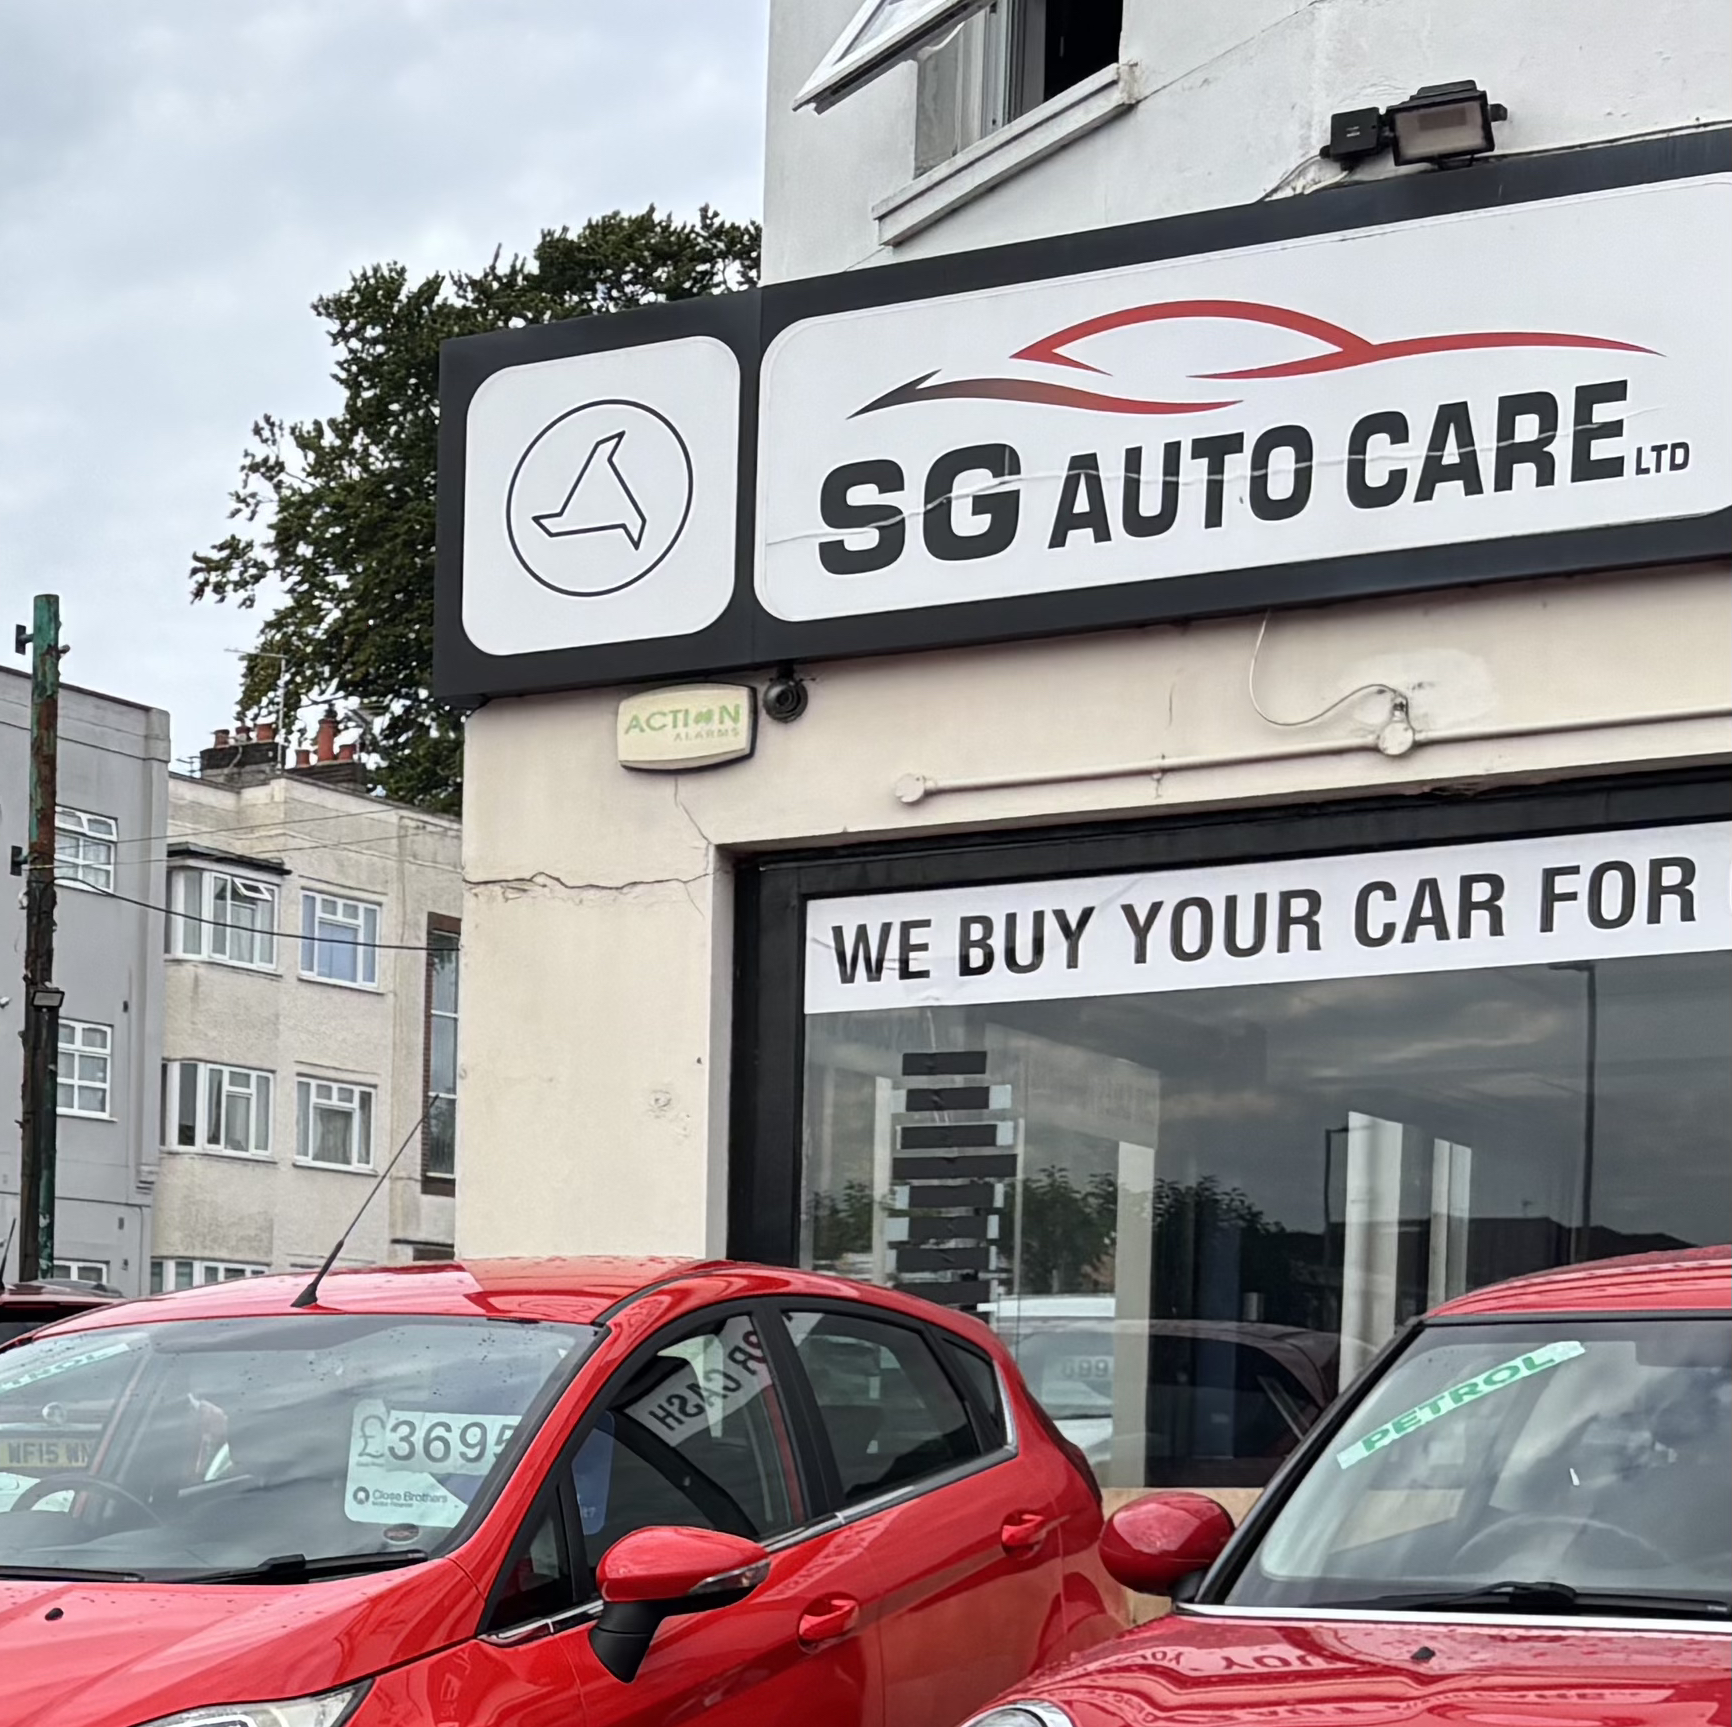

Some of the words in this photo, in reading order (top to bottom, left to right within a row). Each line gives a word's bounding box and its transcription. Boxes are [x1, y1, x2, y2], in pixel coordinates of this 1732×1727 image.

[818, 442, 1021, 576] SG
[1048, 424, 1315, 550] AUTO
[1345, 379, 1629, 509] CARE
[1634, 440, 1691, 477] LTD
[673, 727, 740, 743] ALARMS
[830, 918, 933, 985] WE
[957, 905, 1096, 978] BUY
[1120, 887, 1323, 966] YOUR
[1353, 872, 1506, 948] CAR
[1538, 855, 1697, 934] FOR
[1360, 1355, 1556, 1454] PETROL
